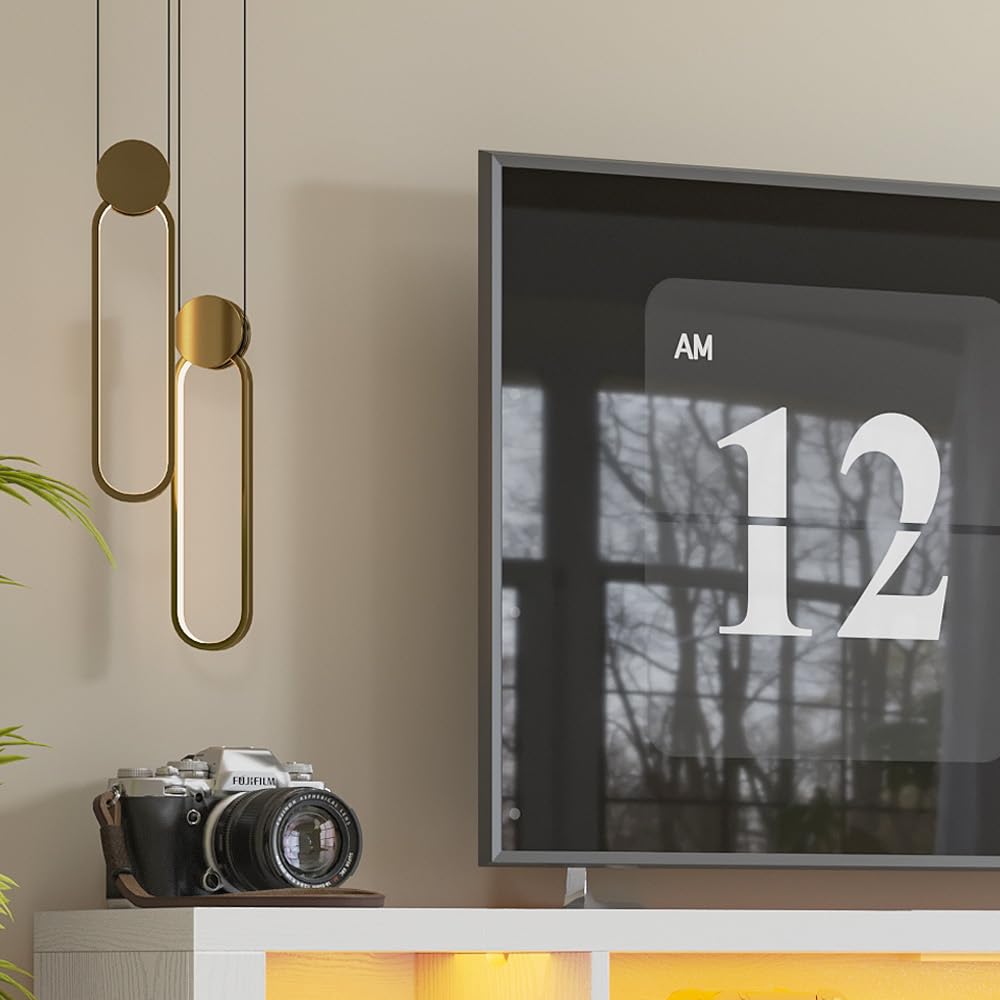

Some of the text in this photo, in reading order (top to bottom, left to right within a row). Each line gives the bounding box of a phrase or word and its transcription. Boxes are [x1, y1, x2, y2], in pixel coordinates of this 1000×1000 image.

[674, 333, 713, 361] AM
[717, 406, 948, 640] 12
[232, 775, 276, 786] FUJIFILM
